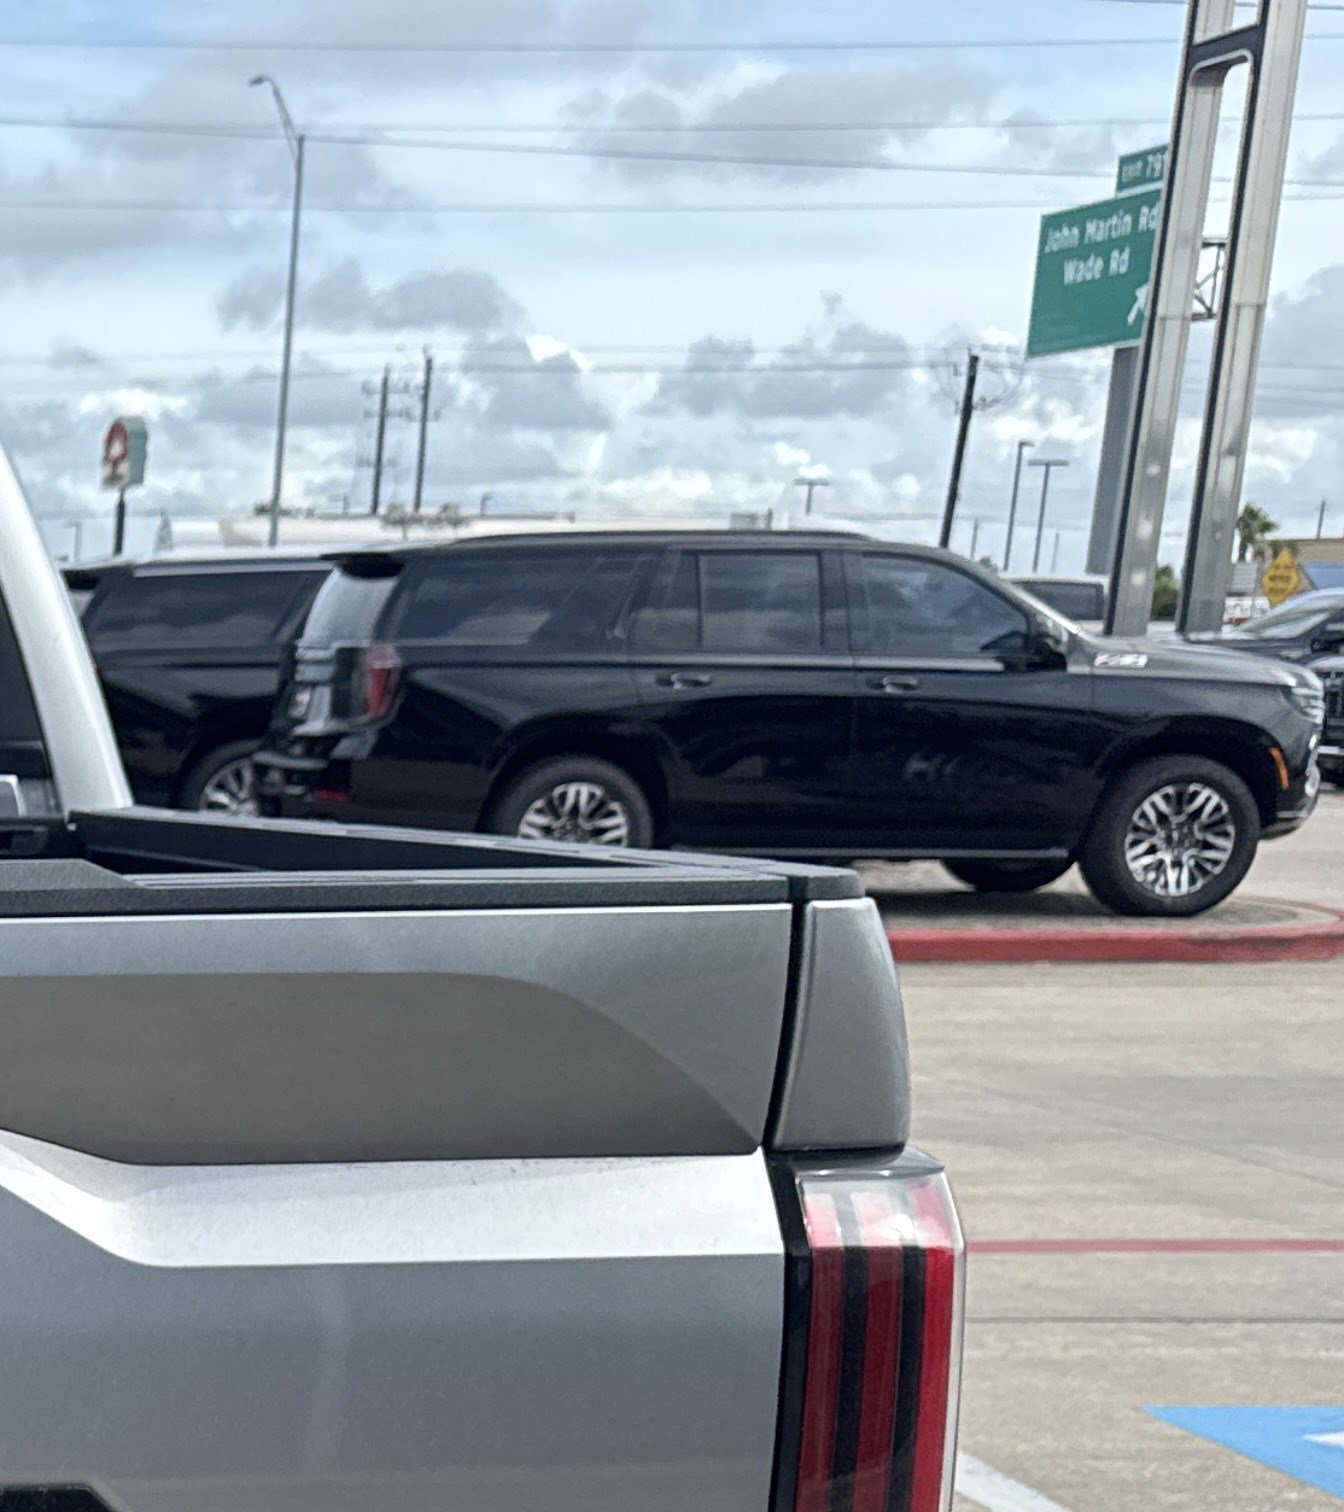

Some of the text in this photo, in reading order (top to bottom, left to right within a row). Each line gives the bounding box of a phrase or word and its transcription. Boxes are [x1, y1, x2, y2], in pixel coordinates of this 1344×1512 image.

[1044, 223, 1080, 254] John
[1084, 208, 1132, 244] Martin
[1063, 245, 1130, 285] Wade Rd
